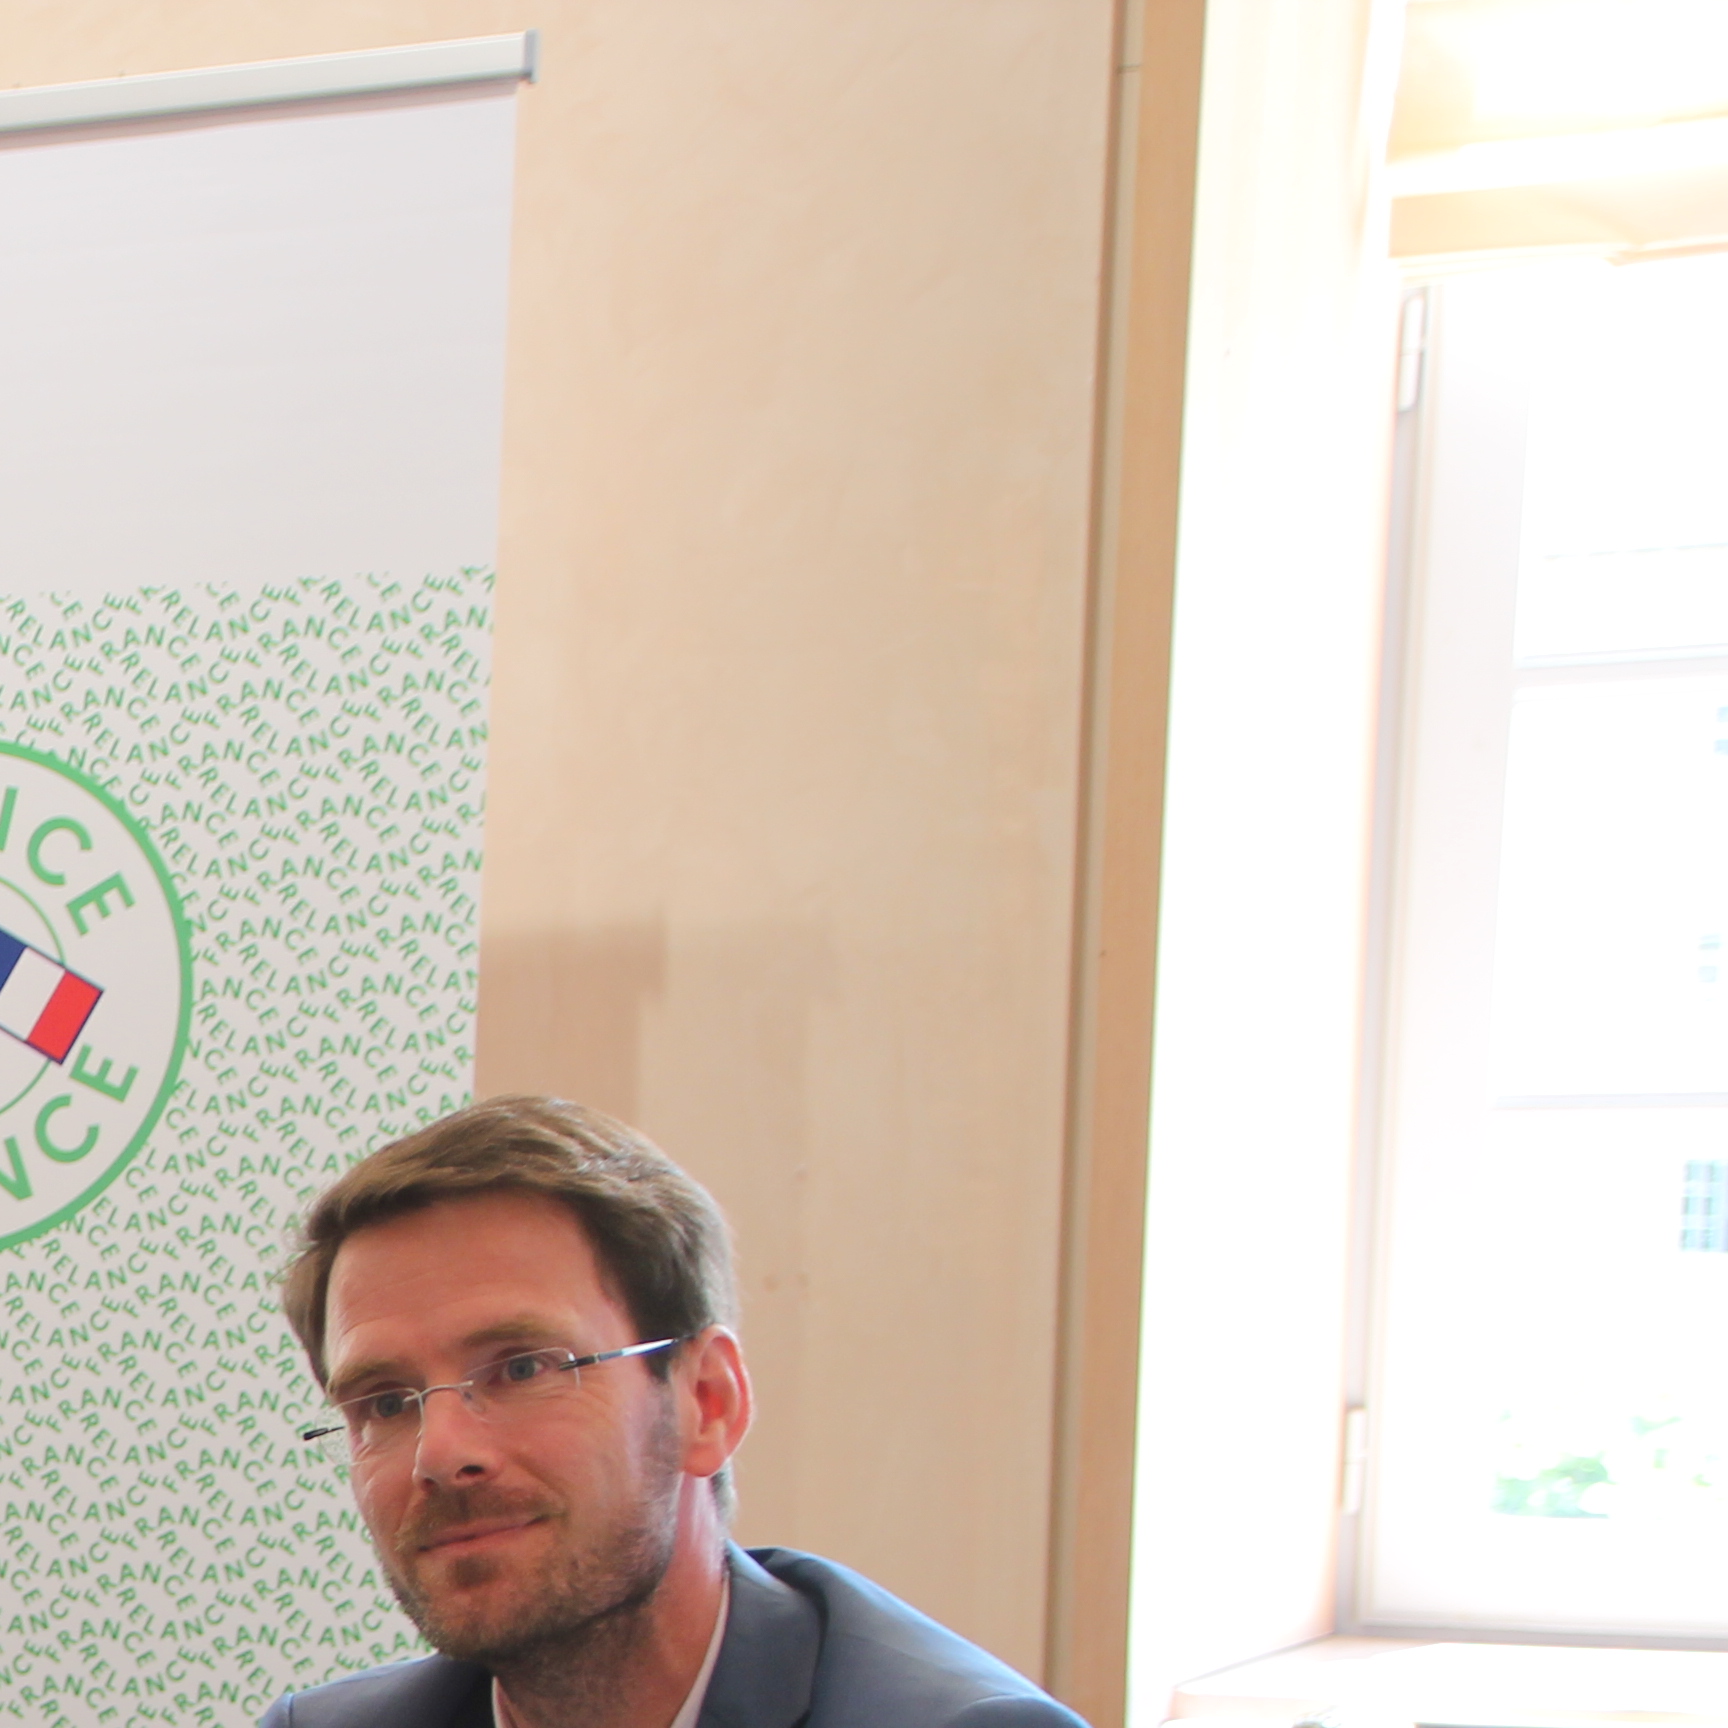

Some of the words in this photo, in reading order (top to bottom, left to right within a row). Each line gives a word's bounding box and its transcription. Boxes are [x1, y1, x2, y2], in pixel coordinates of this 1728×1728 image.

[84, 624, 198, 678] FRANCE
[239, 615, 357, 670] FRANCE
[274, 637, 397, 697] RELANCE
[118, 646, 237, 704] RELANCE
[200, 677, 317, 731] FRANCE
[234, 700, 356, 758] RELANCE
[278, 793, 397, 847] FRANCE
[313, 817, 437, 875] RELANCE
[238, 854, 356, 908] FRANCE
[273, 878, 396, 936] RELANCE
[199, 915, 316, 968] FRANCE
[234, 939, 355, 997] RELANCE
[317, 972, 437, 1025] FRANCE
[352, 997, 477, 1054] RELANCE
[45, 1386, 157, 1437] FRANCE
[78, 1412, 195, 1467] RELANCE
[159, 1447, 274, 1498] FRANCE
[193, 1473, 313, 1528] RELANCE
[44, 1618, 157, 1669] FRANCE
[77, 1643, 194, 1698] RELANCE
